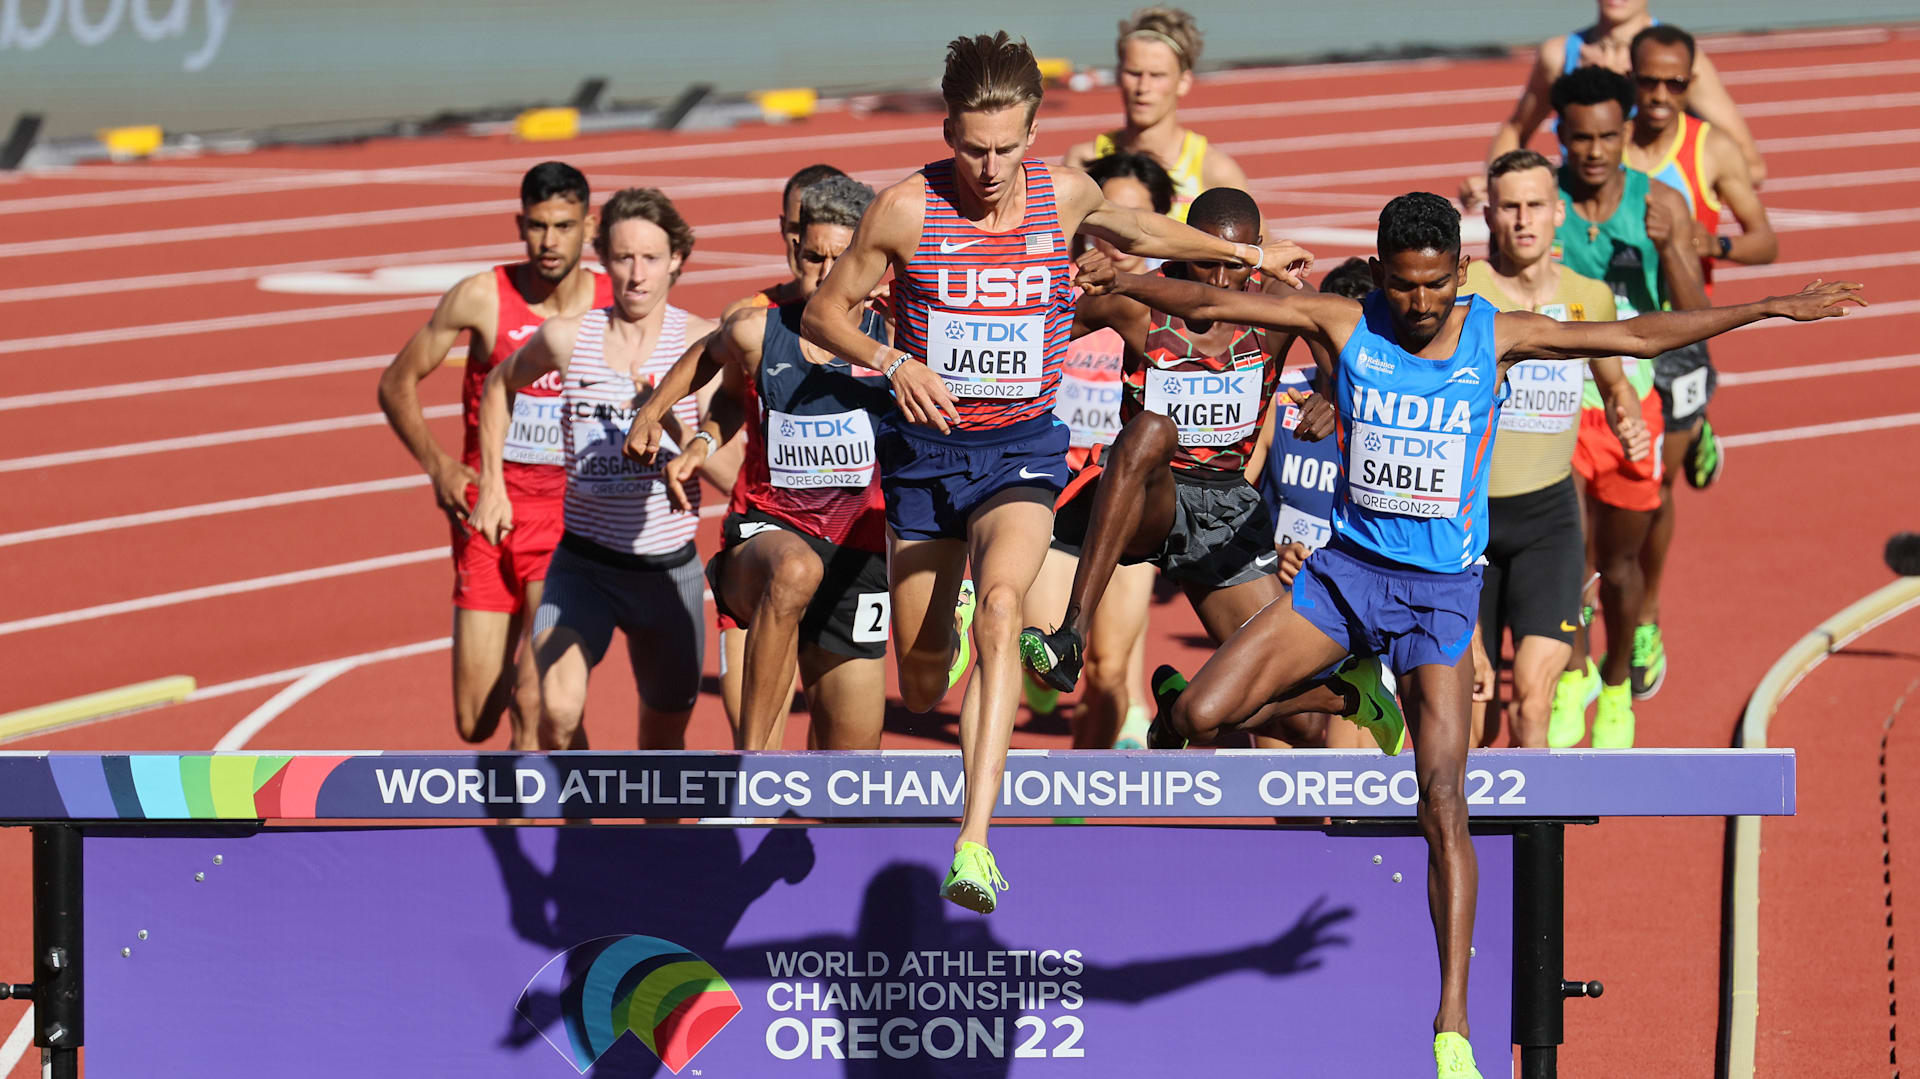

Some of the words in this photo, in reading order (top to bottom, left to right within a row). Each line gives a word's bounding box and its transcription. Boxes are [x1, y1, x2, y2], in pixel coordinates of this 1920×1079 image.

[938, 265, 1051, 307] USA
[965, 322, 1029, 342] TDK
[943, 348, 1027, 375] JAGER
[1515, 365, 1567, 382] TDK
[945, 381, 1024, 396] OREGON22
[1182, 376, 1246, 395] TDK
[1167, 403, 1240, 425] KIGEN
[1352, 386, 1471, 434] INDIA
[794, 417, 857, 438] TDK
[1178, 431, 1240, 444] REGON22
[775, 440, 870, 467] JHINAOUI
[1383, 435, 1449, 460] TDK
[786, 474, 862, 486] OREGON22
[1281, 453, 1338, 493] NOR
[1362, 459, 1445, 493] SABLE
[1362, 494, 1440, 515] OREGON22
[868, 602, 883, 632] 2
[375, 768, 546, 804] WORLD
[558, 768, 812, 806] ATHLETICS
[827, 769, 1223, 806] CHAMIONSHIPS
[1258, 770, 1420, 806] OREGO
[1466, 769, 1527, 805] 22
[765, 950, 890, 978] WORLD
[898, 949, 1084, 977] ATHLETICS
[766, 980, 1084, 1011] CHAMPIONSHIPS
[765, 1016, 1005, 1060] OREGON
[1014, 1015, 1085, 1058] 22
